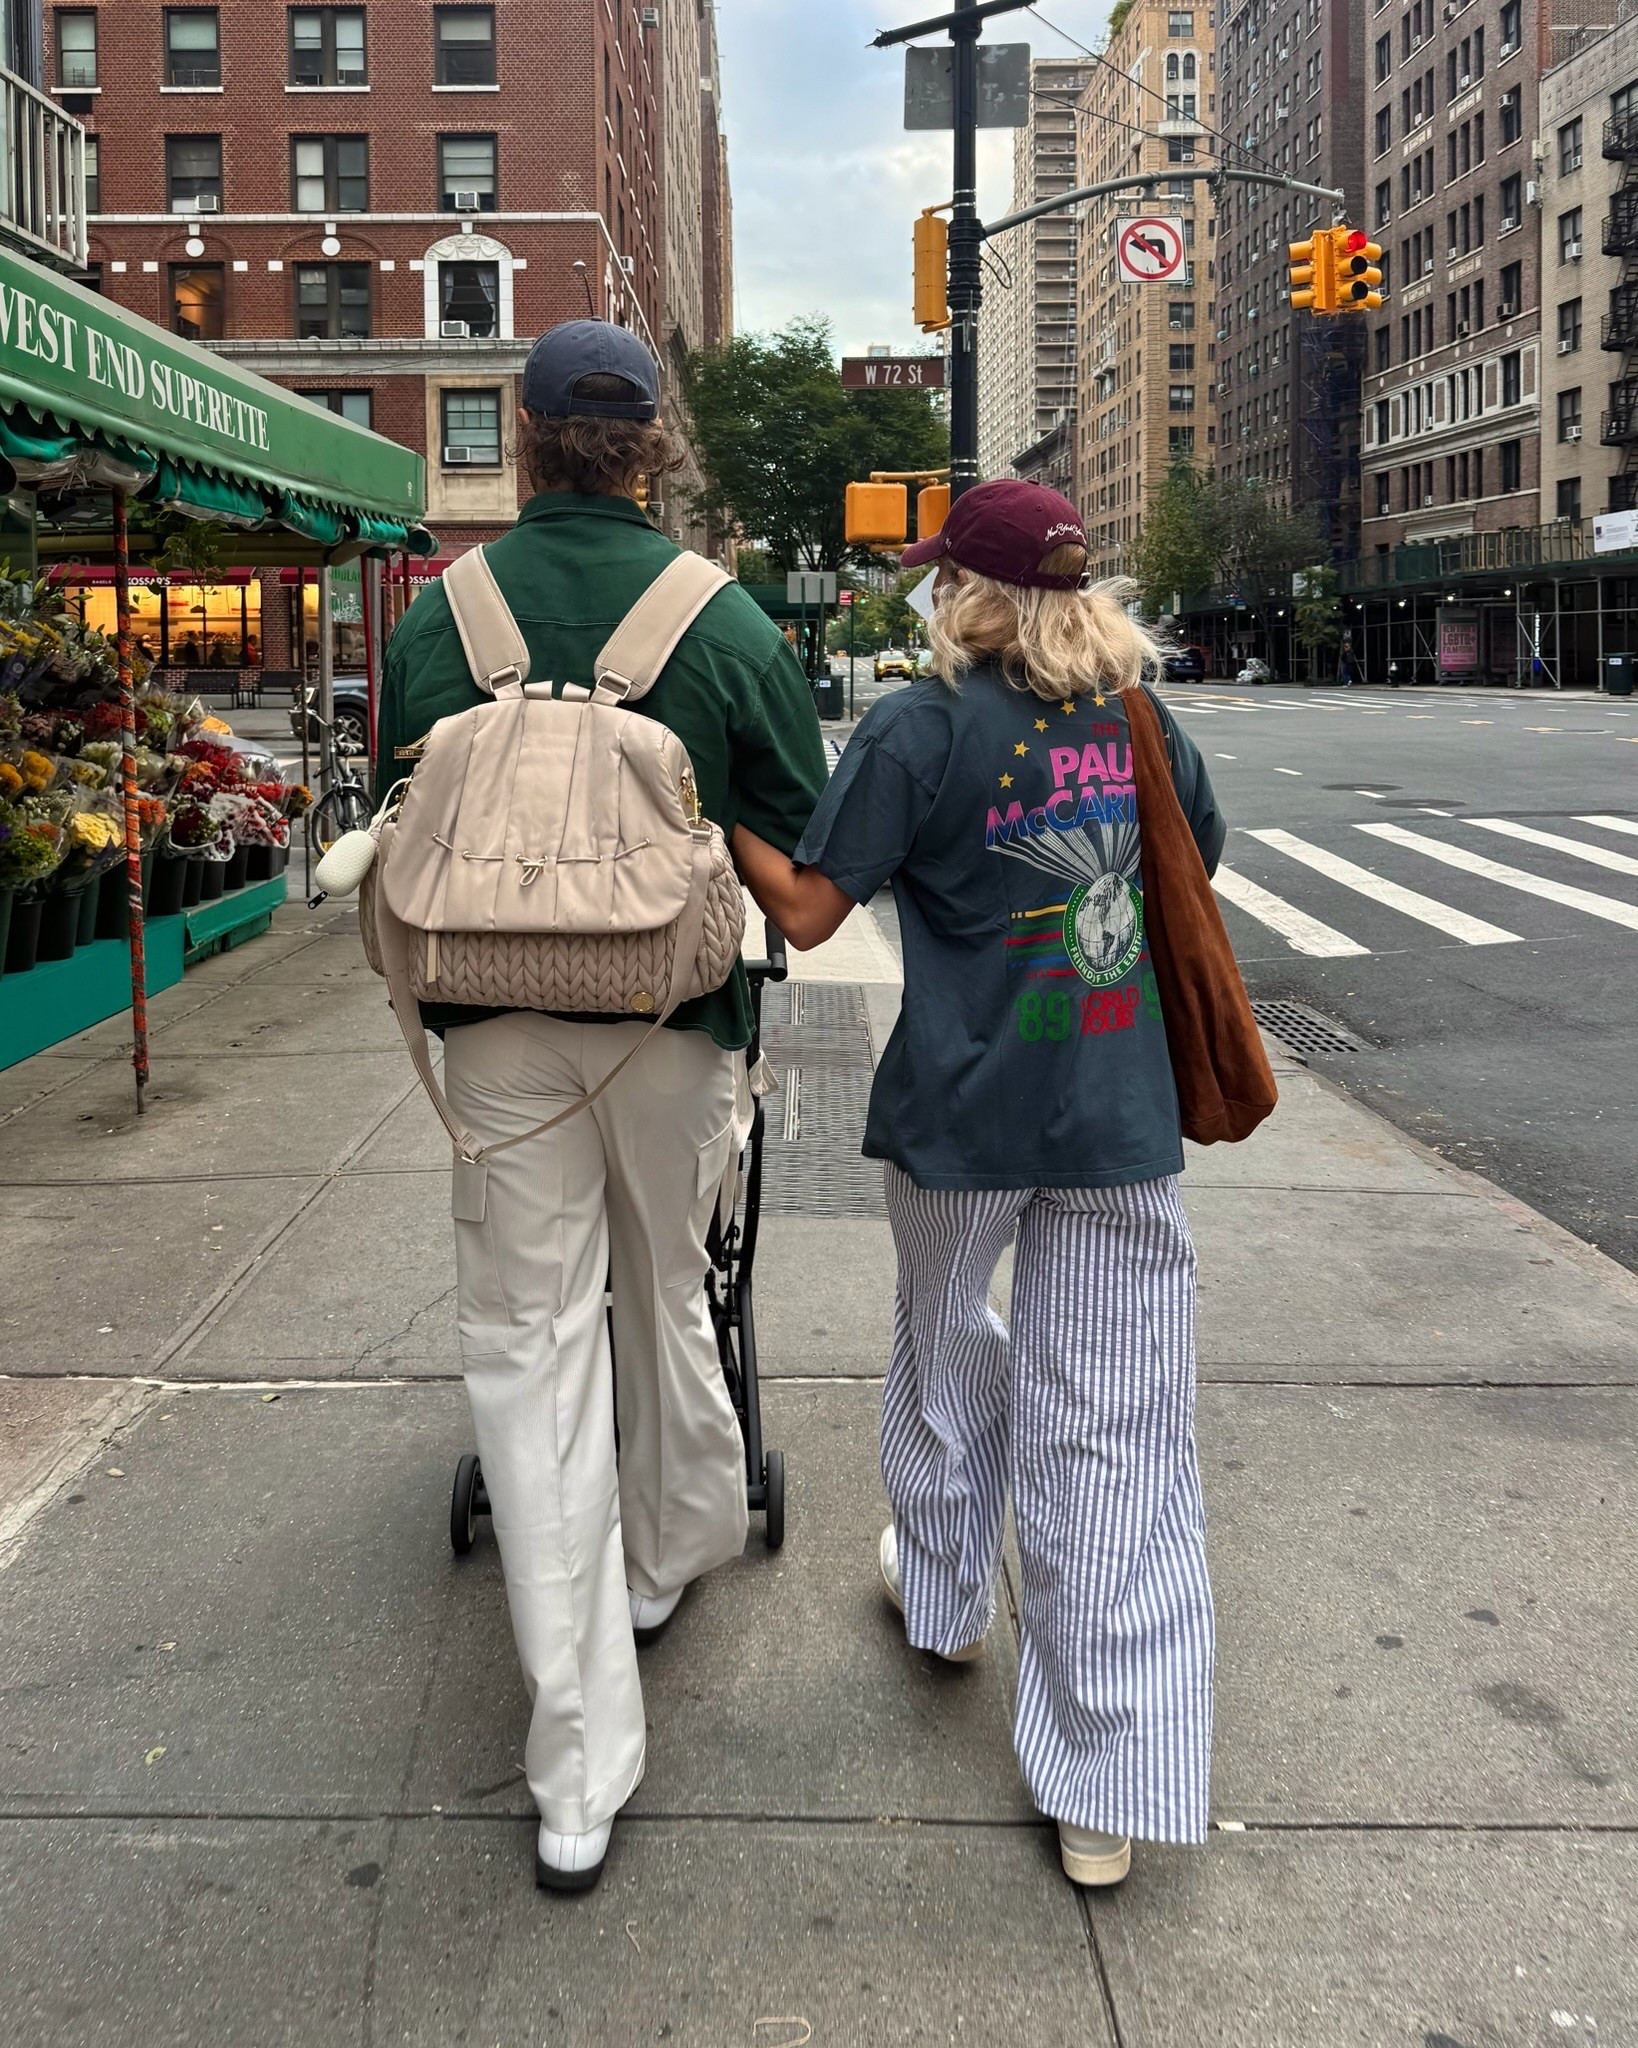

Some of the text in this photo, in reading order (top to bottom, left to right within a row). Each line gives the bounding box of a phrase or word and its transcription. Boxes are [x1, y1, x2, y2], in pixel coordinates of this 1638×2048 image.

[84, 324, 146, 401] END
[150, 359, 270, 452] SUPERETTE
[864, 364, 923, 385] W 72 St
[1091, 721, 1120, 737] THE
[1049, 742, 1134, 788] PAU
[984, 784, 1137, 849] McCART
[1103, 966, 1123, 982] THE
[1123, 931, 1143, 967] EARTH
